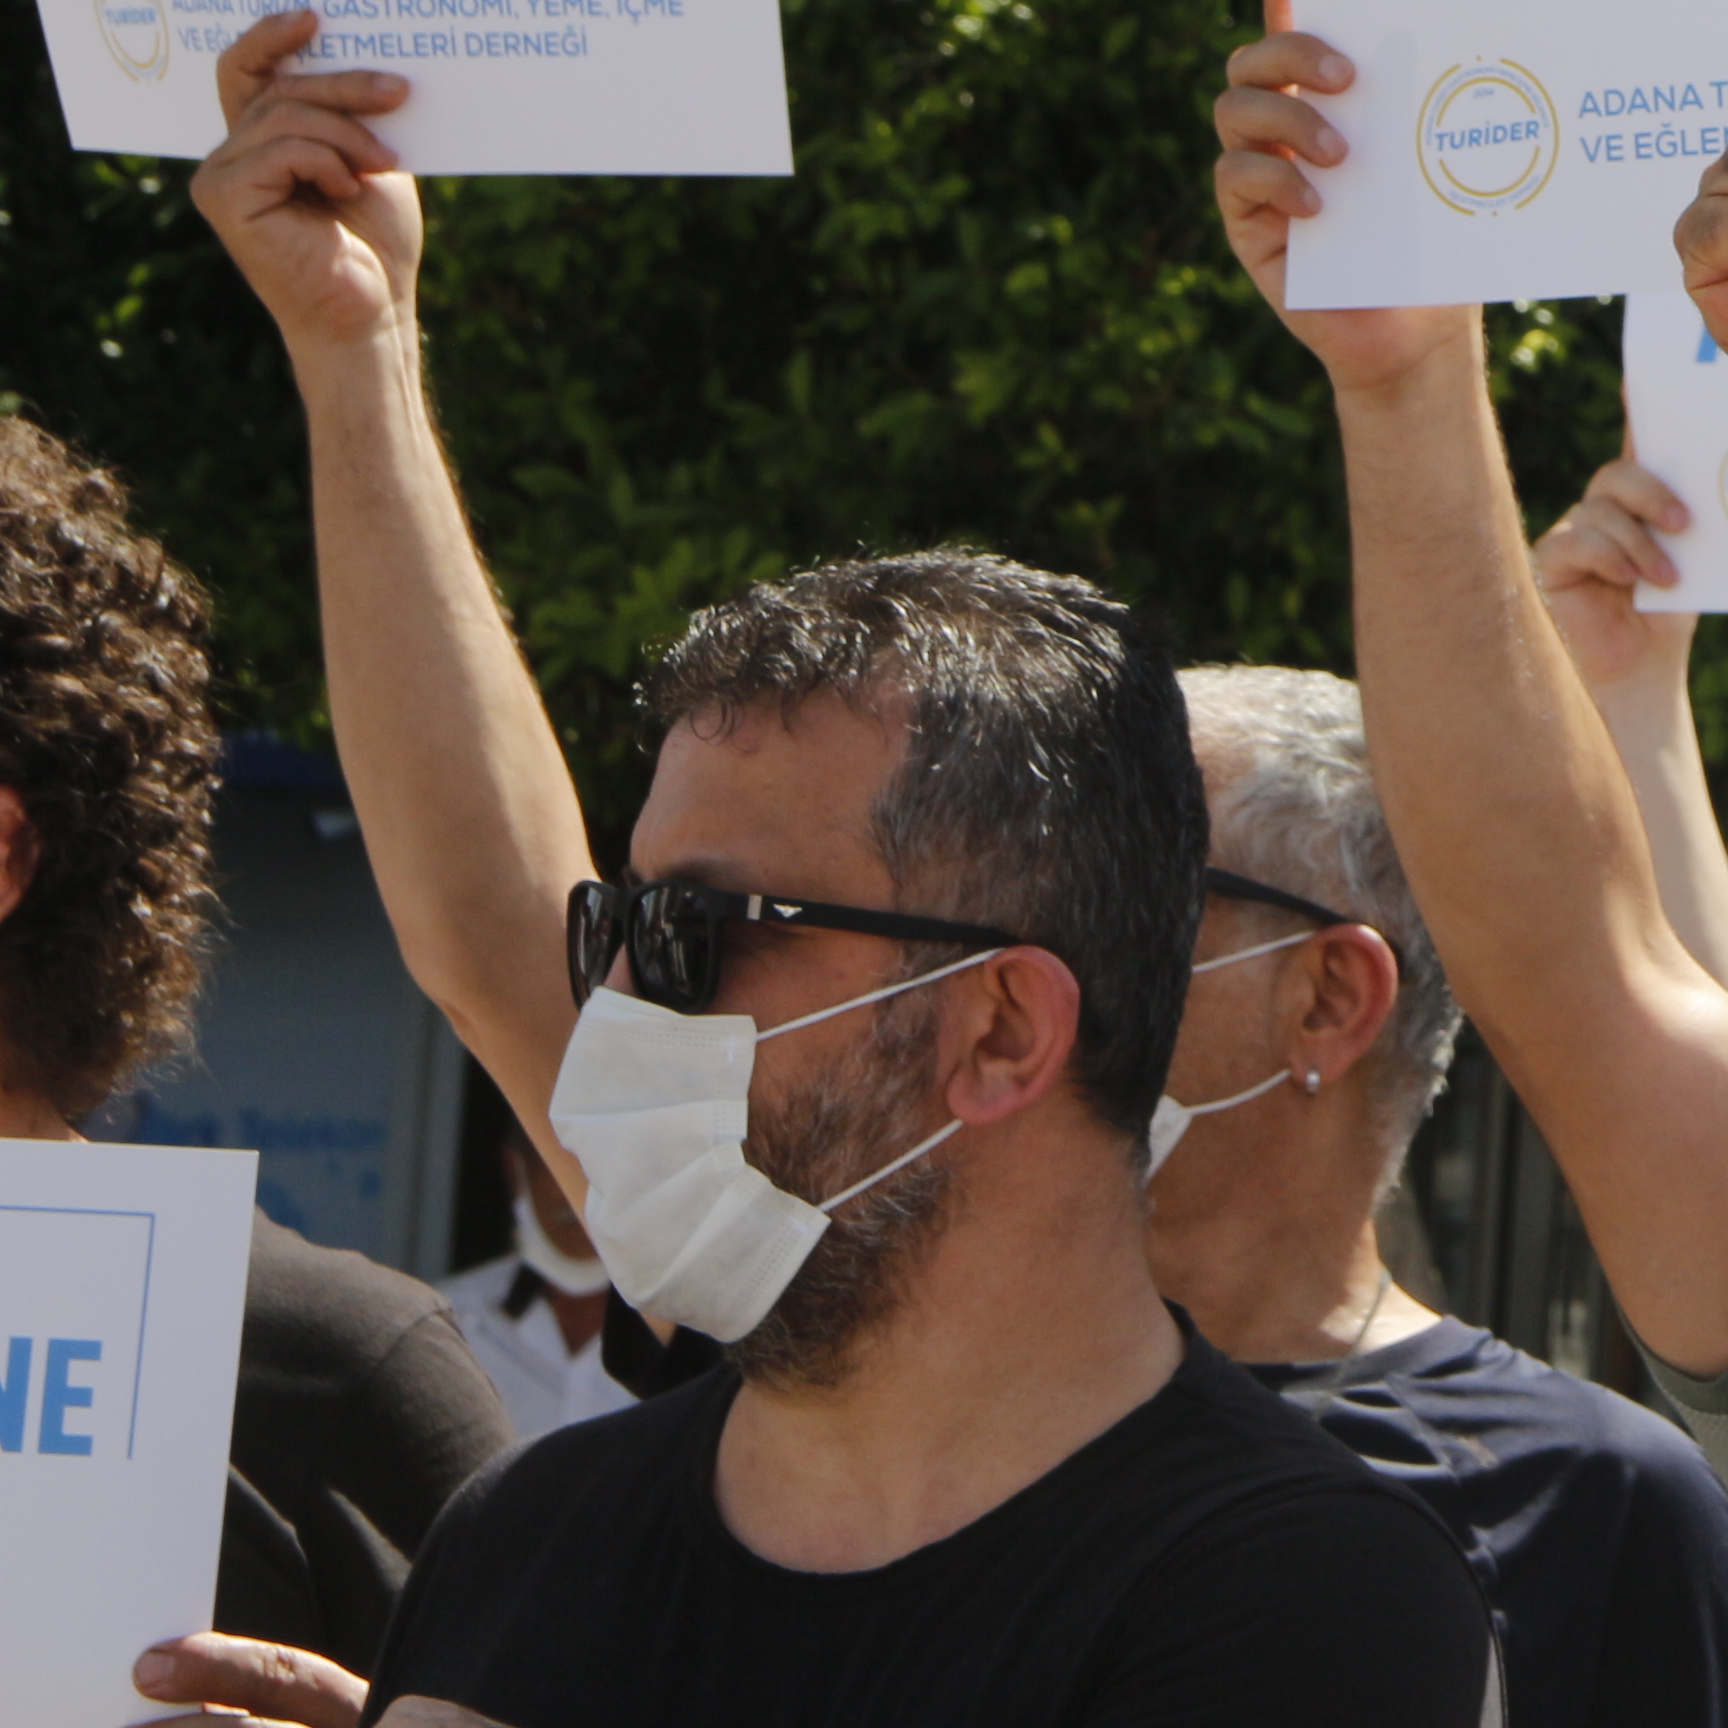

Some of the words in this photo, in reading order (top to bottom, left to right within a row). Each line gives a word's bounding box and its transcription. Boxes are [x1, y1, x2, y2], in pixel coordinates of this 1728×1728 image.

[177, 26, 202, 51] VE
[297, 27, 457, 65] LETMELERİ
[465, 25, 589, 57] DERNEĞİ
[1581, 84, 1703, 115] ADANA
[1434, 120, 1541, 152] TURİDER
[1581, 134, 1624, 161] VE
